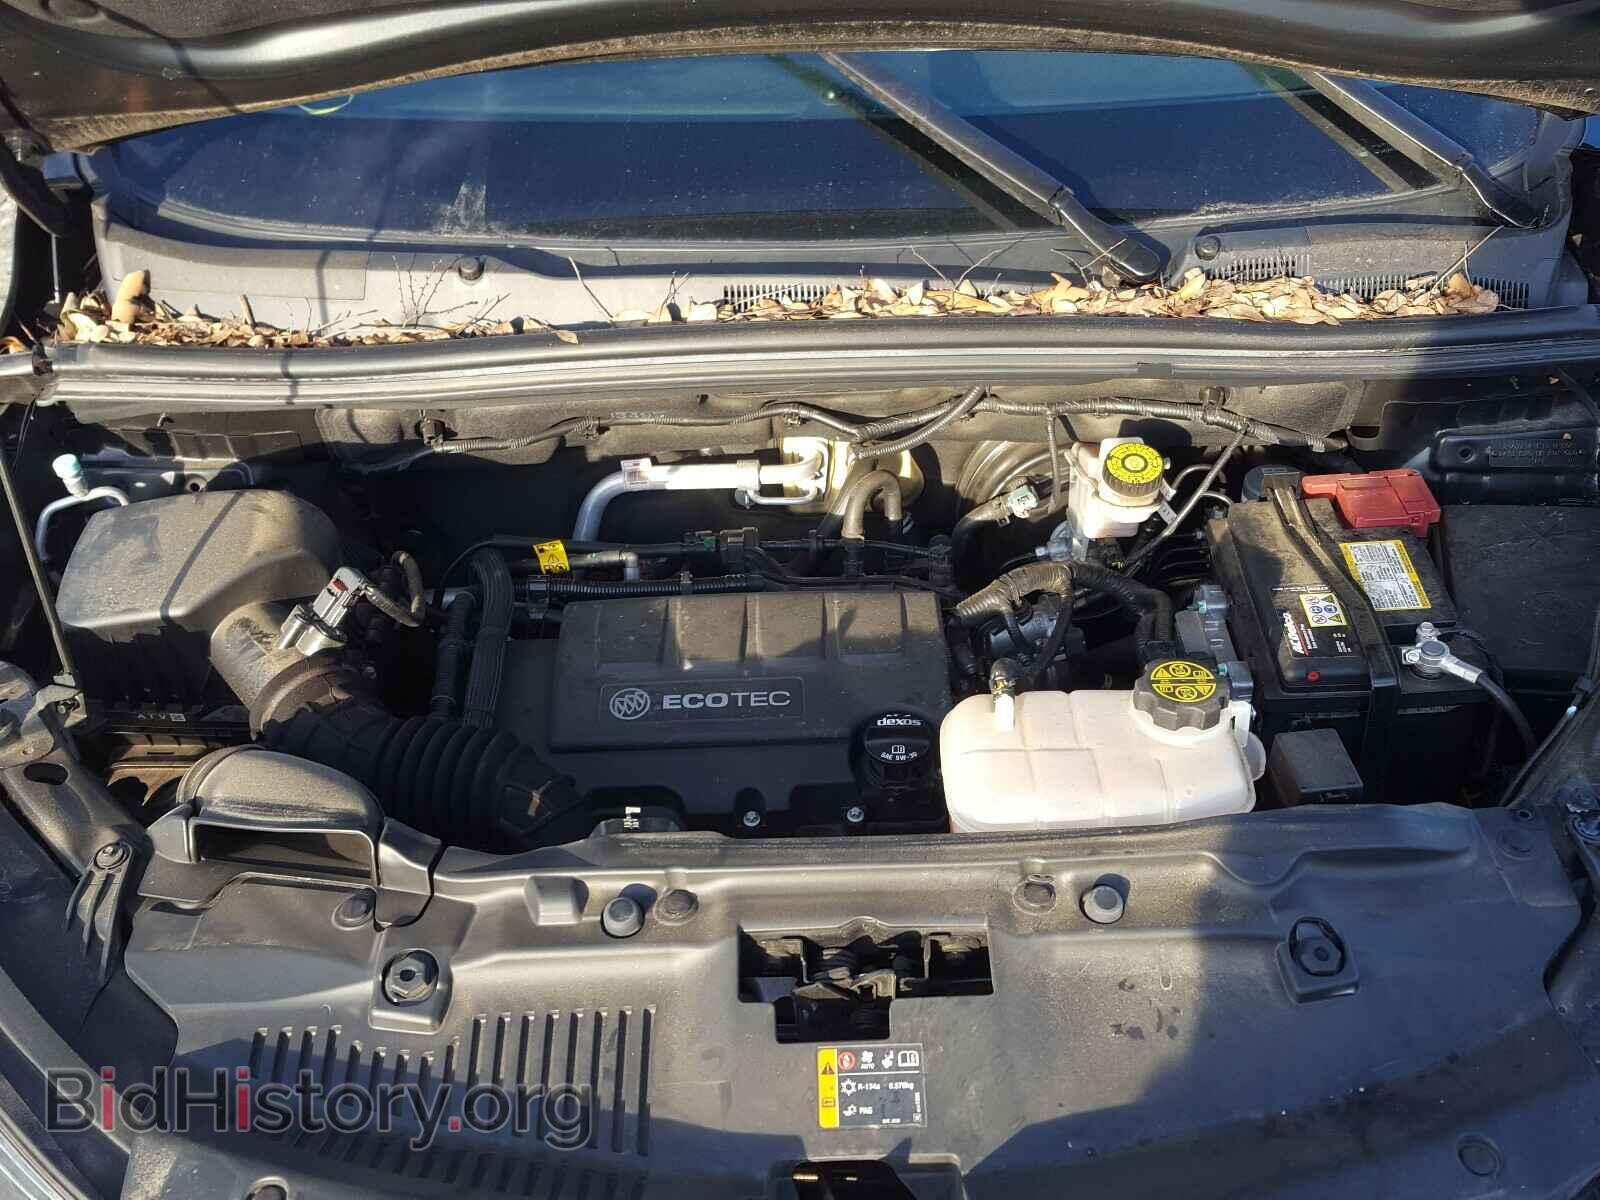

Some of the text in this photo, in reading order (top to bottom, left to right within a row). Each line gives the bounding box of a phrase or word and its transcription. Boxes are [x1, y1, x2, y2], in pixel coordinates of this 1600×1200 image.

[663, 691, 791, 709] ECOTEC
[876, 717, 922, 726] dexos
[880, 752, 894, 761] SAE
